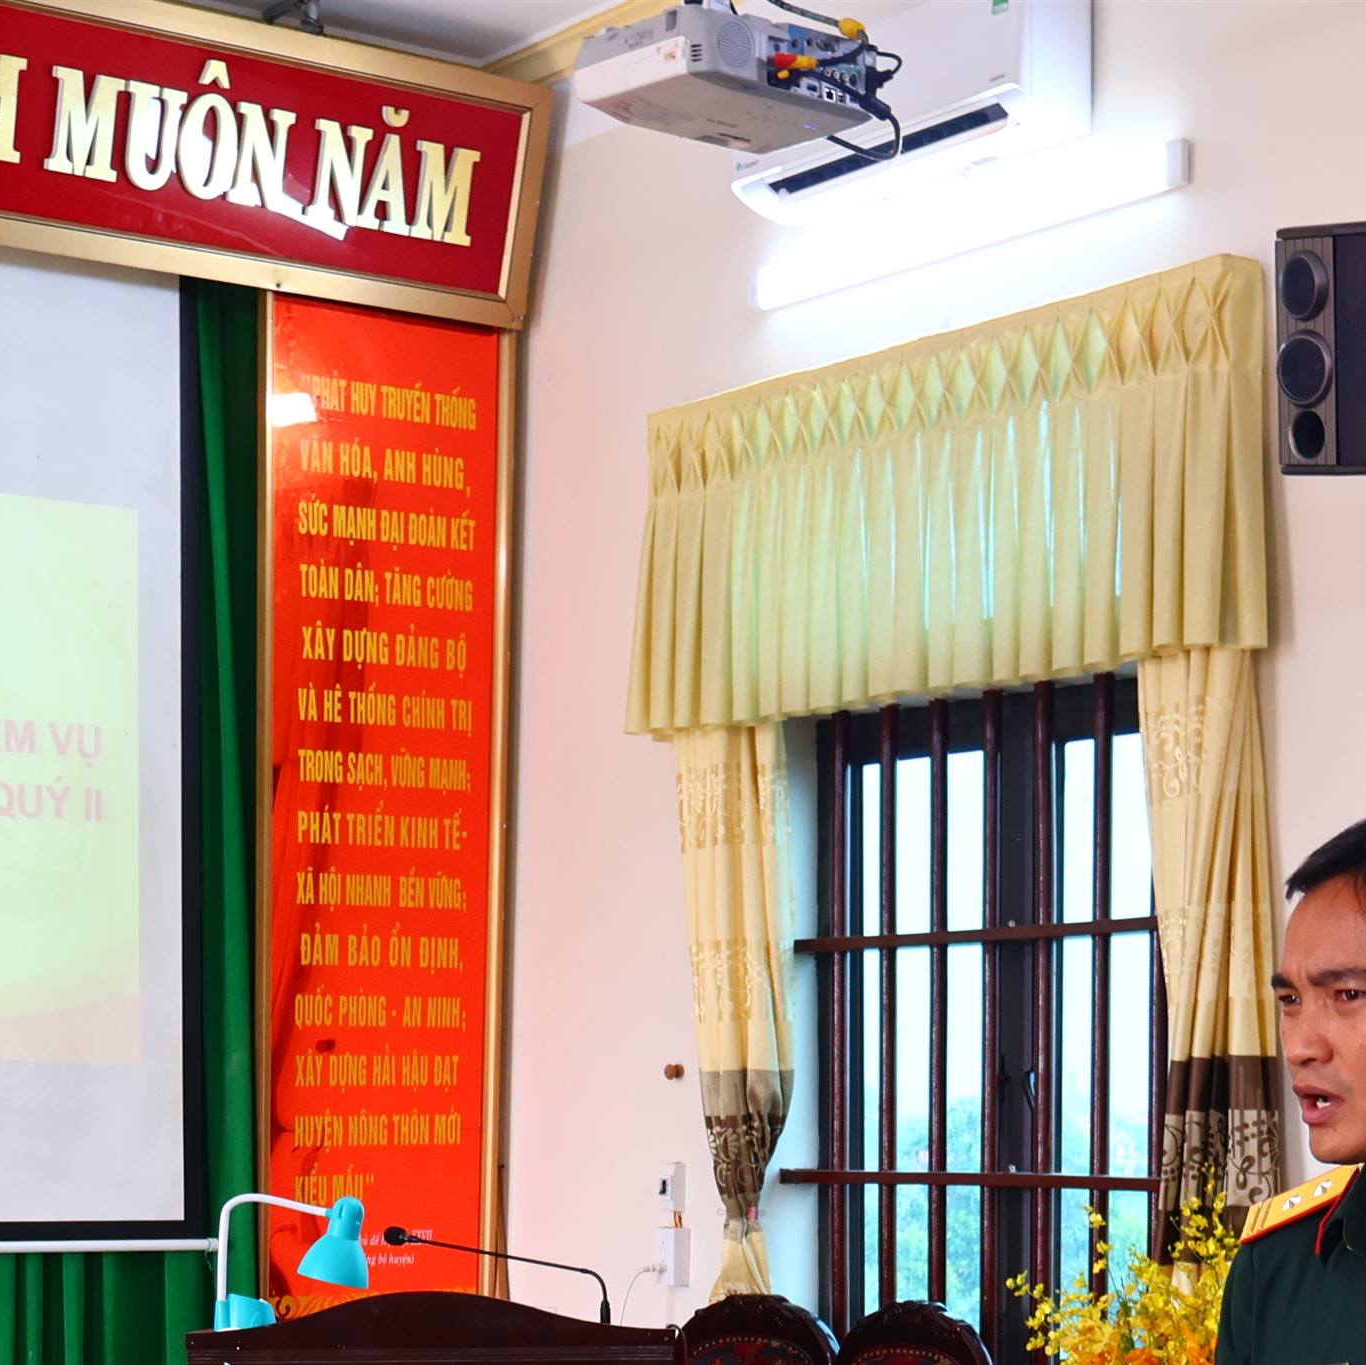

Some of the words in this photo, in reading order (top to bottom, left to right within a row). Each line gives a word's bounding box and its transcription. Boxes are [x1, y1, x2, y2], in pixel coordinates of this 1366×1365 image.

[44, 59, 298, 216] MUÔN
[307, 106, 481, 247] NĂM
[350, 381, 377, 417] HUY
[434, 386, 476, 431] THỐNG
[300, 434, 333, 474] VĂN
[340, 437, 378, 484] HÓA,
[384, 449, 416, 484] ANH
[298, 494, 328, 535] SỨC
[333, 503, 377, 546] MẠNH
[380, 509, 404, 551] ĐẠI
[408, 508, 446, 548] ĐOÀN
[450, 509, 476, 551] KẾT
[299, 558, 339, 600] TOÀN
[345, 562, 379, 607] DÂN;
[384, 566, 421, 608] TĂNG
[426, 569, 473, 612] CƯỜNG
[302, 620, 335, 660] XÂY
[343, 627, 389, 670] DỰNG
[395, 623, 439, 669] ĐẢNG
[446, 633, 467, 678] BỘ
[298, 682, 318, 722] VÀ
[348, 682, 396, 727] THỐNG
[402, 690, 445, 730] CHÍNH
[450, 699, 472, 738] TRỊ
[49, 720, 103, 768] VỤ
[298, 749, 343, 784] TRONG
[347, 752, 387, 792] SẠCH,
[391, 747, 425, 788] VỮNG
[429, 757, 471, 795] MẠNH;
[83, 789, 104, 823] II
[297, 804, 341, 844] PHÁT
[346, 800, 395, 846] TRIỂN
[400, 816, 438, 849] KINH
[296, 866, 315, 905] XÃ
[319, 866, 341, 912] HỘI
[346, 874, 391, 907] NHANH
[300, 922, 339, 966] ĐẢM
[348, 923, 381, 967] BẢO
[389, 922, 411, 967] ỔN
[295, 984, 333, 1030] QUỐC
[339, 987, 386, 1027] PHÒNG
[403, 996, 422, 1028] AN
[427, 996, 466, 1032] NINH;
[295, 1048, 323, 1087] XÂY
[329, 1052, 367, 1093] DỰNG
[373, 1043, 396, 1086] HẢI
[402, 1049, 429, 1093] HẬU
[434, 1055, 459, 1093] ĐẠT
[294, 1109, 343, 1153] HUYỆN
[348, 1109, 387, 1147] NÔNG
[393, 1108, 429, 1146] THÔN
[434, 1105, 462, 1145] MỚI
[295, 1162, 327, 1206] KIỂU
